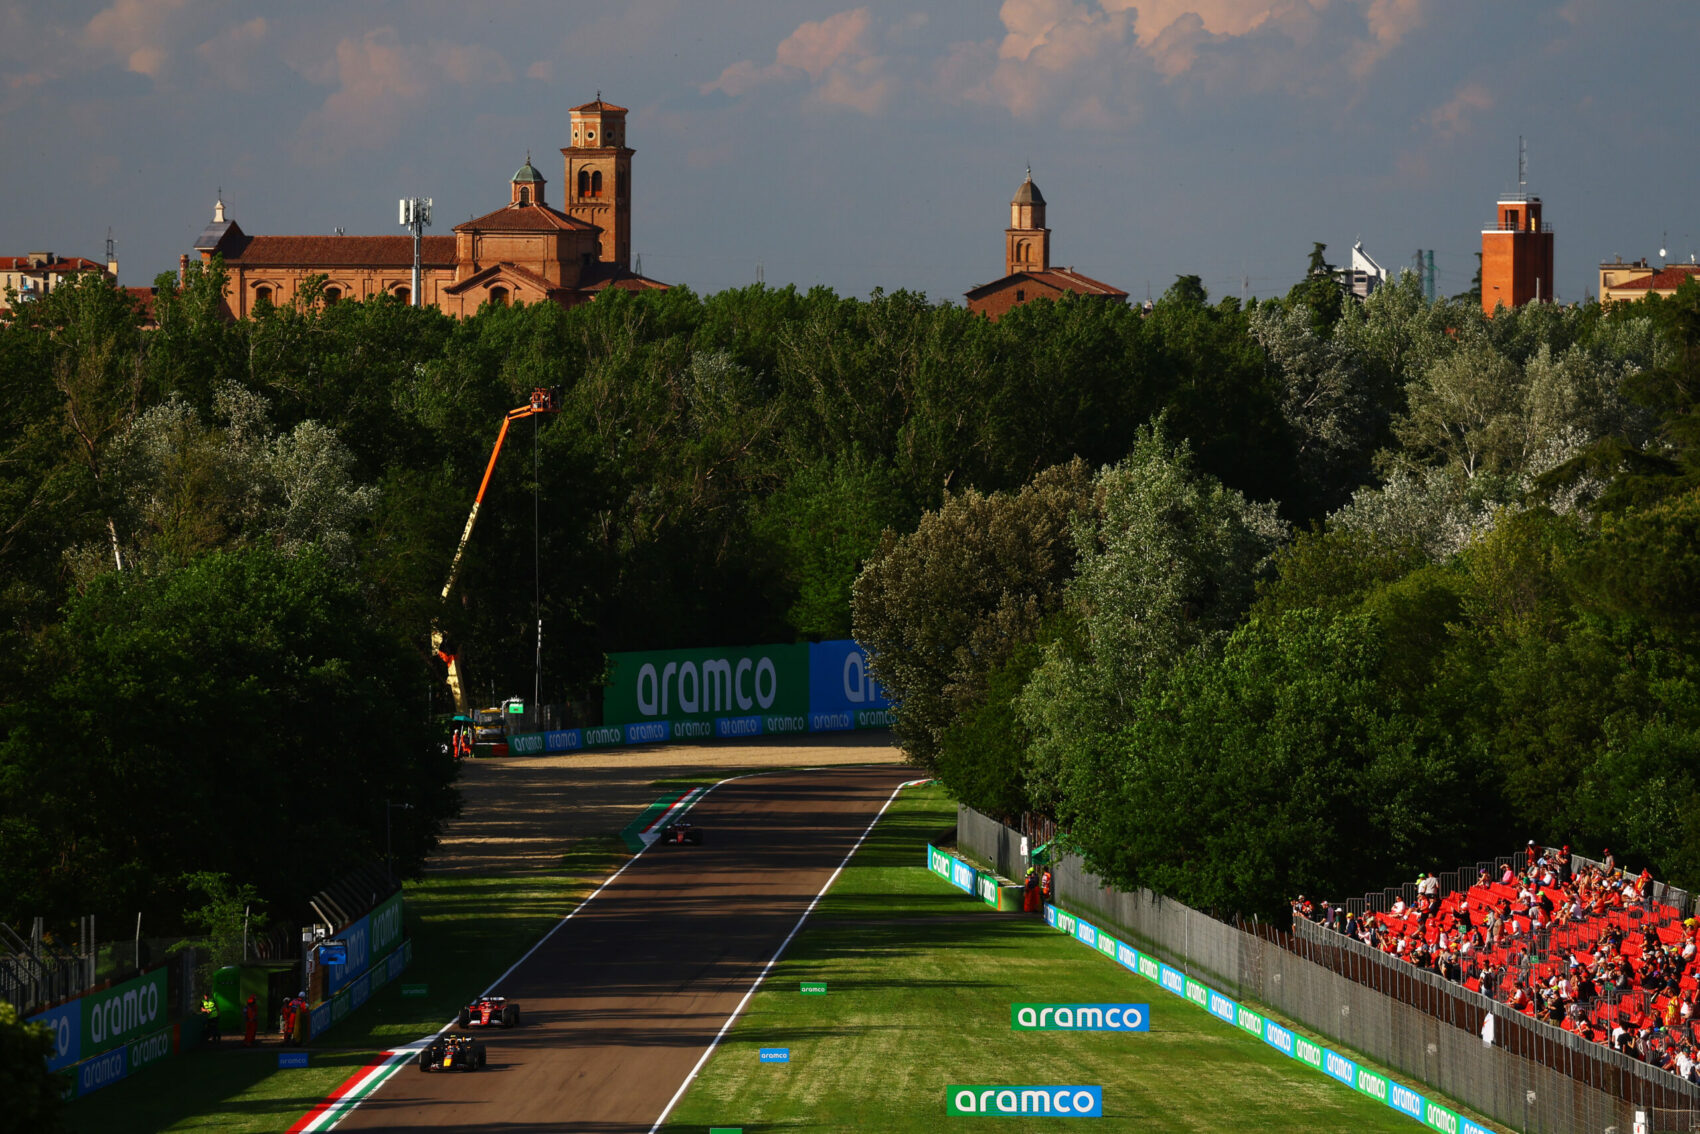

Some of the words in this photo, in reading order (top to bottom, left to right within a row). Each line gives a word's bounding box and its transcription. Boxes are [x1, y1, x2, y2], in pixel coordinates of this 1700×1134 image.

[637, 656, 777, 716] aramco
[629, 724, 664, 740] aramco
[674, 719, 711, 737] aramco
[720, 718, 757, 735] aramco
[767, 715, 804, 732] aramco
[813, 712, 849, 729] aramco
[514, 735, 542, 753] aramco
[586, 728, 621, 745] aramco
[1162, 967, 1182, 993] aramco
[1186, 980, 1207, 1006] aramco
[91, 981, 158, 1044] aramco
[1017, 1007, 1142, 1028] aramco
[1211, 994, 1233, 1021] aramco
[1238, 1007, 1262, 1035] aramco
[132, 1032, 168, 1067] aramco
[1267, 1023, 1291, 1052] aramco
[1296, 1039, 1321, 1067] aramco
[83, 1053, 122, 1088] aramco
[1327, 1053, 1352, 1082] aramco
[1358, 1070, 1386, 1099] aramco
[954, 1090, 1095, 1113] aramco
[1392, 1085, 1420, 1116] aramco
[1427, 1103, 1457, 1134] aramco
